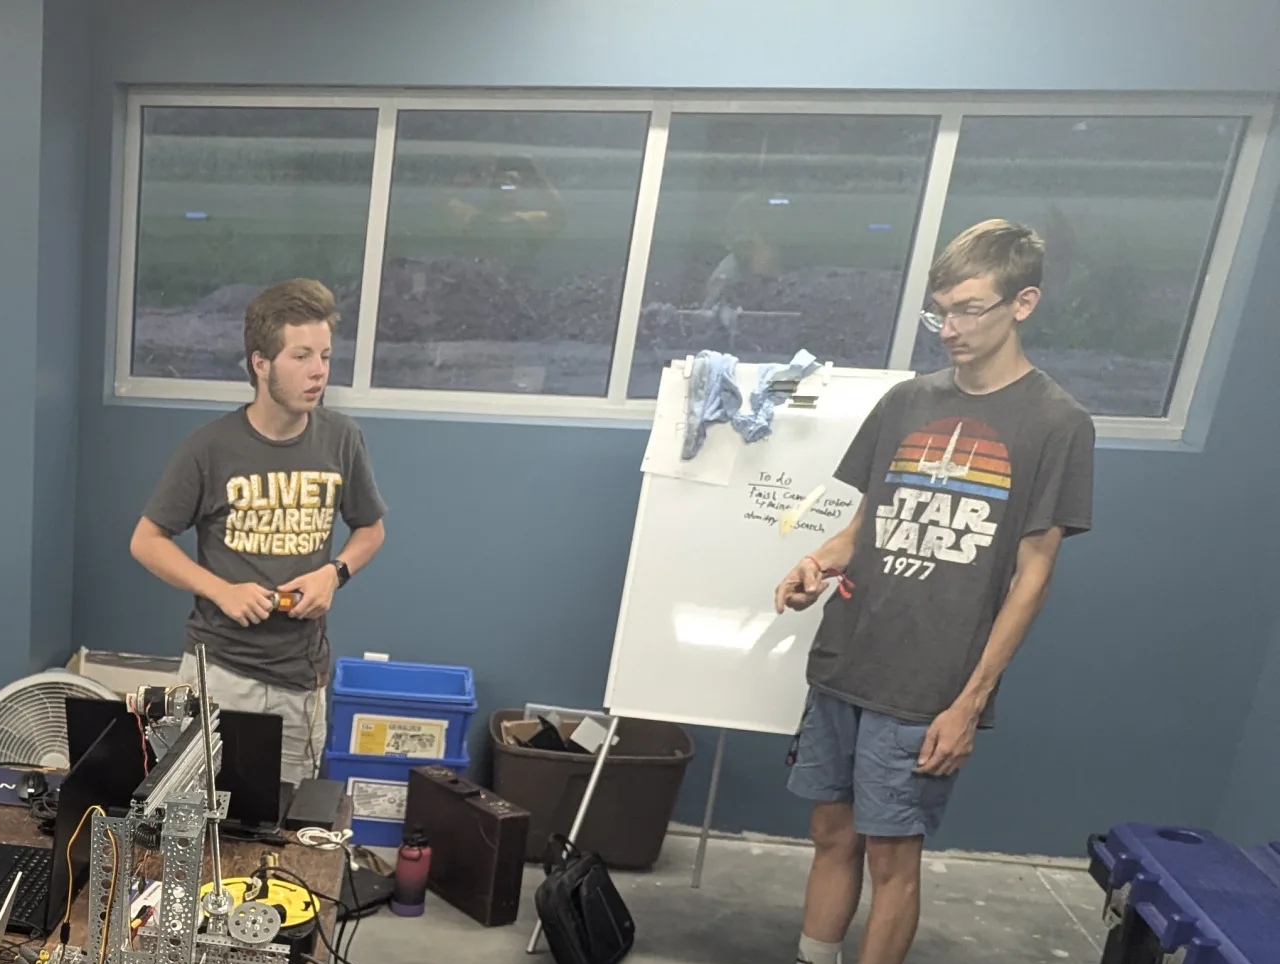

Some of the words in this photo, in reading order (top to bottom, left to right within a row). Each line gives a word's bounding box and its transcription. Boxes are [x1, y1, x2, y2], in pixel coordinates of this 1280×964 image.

[225, 471, 343, 510] OLIVET
[776, 471, 793, 486] do
[225, 506, 335, 534] NAZARENE
[876, 487, 998, 535] STAR
[224, 529, 331, 556] UNIVERSITY
[883, 555, 937, 580] 1977
